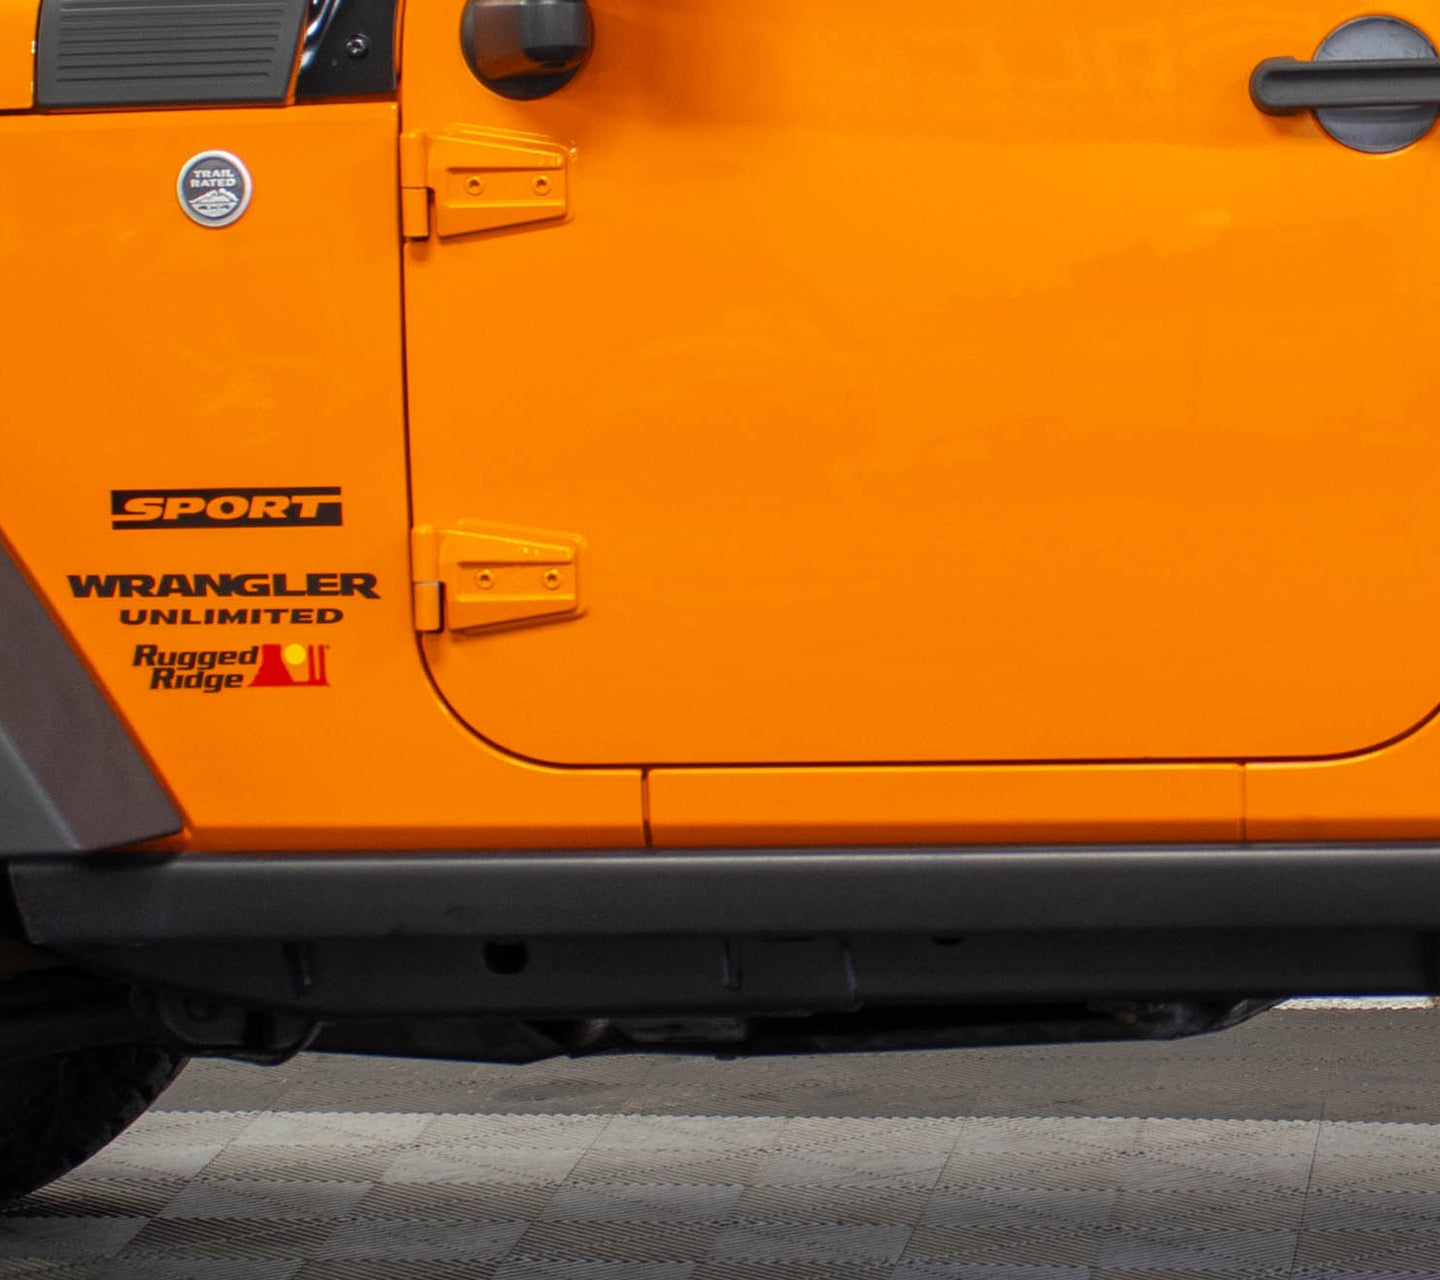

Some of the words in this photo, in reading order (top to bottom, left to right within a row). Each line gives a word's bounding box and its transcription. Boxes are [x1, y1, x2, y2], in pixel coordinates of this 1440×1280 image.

[190, 178, 237, 188] RATED
[192, 168, 235, 179] TRAIL
[113, 493, 342, 523] SPORT
[67, 572, 381, 600] WRANGLER
[119, 607, 344, 626] UNLIMITED
[132, 643, 260, 671] Rugged
[149, 667, 244, 694] Ridge
